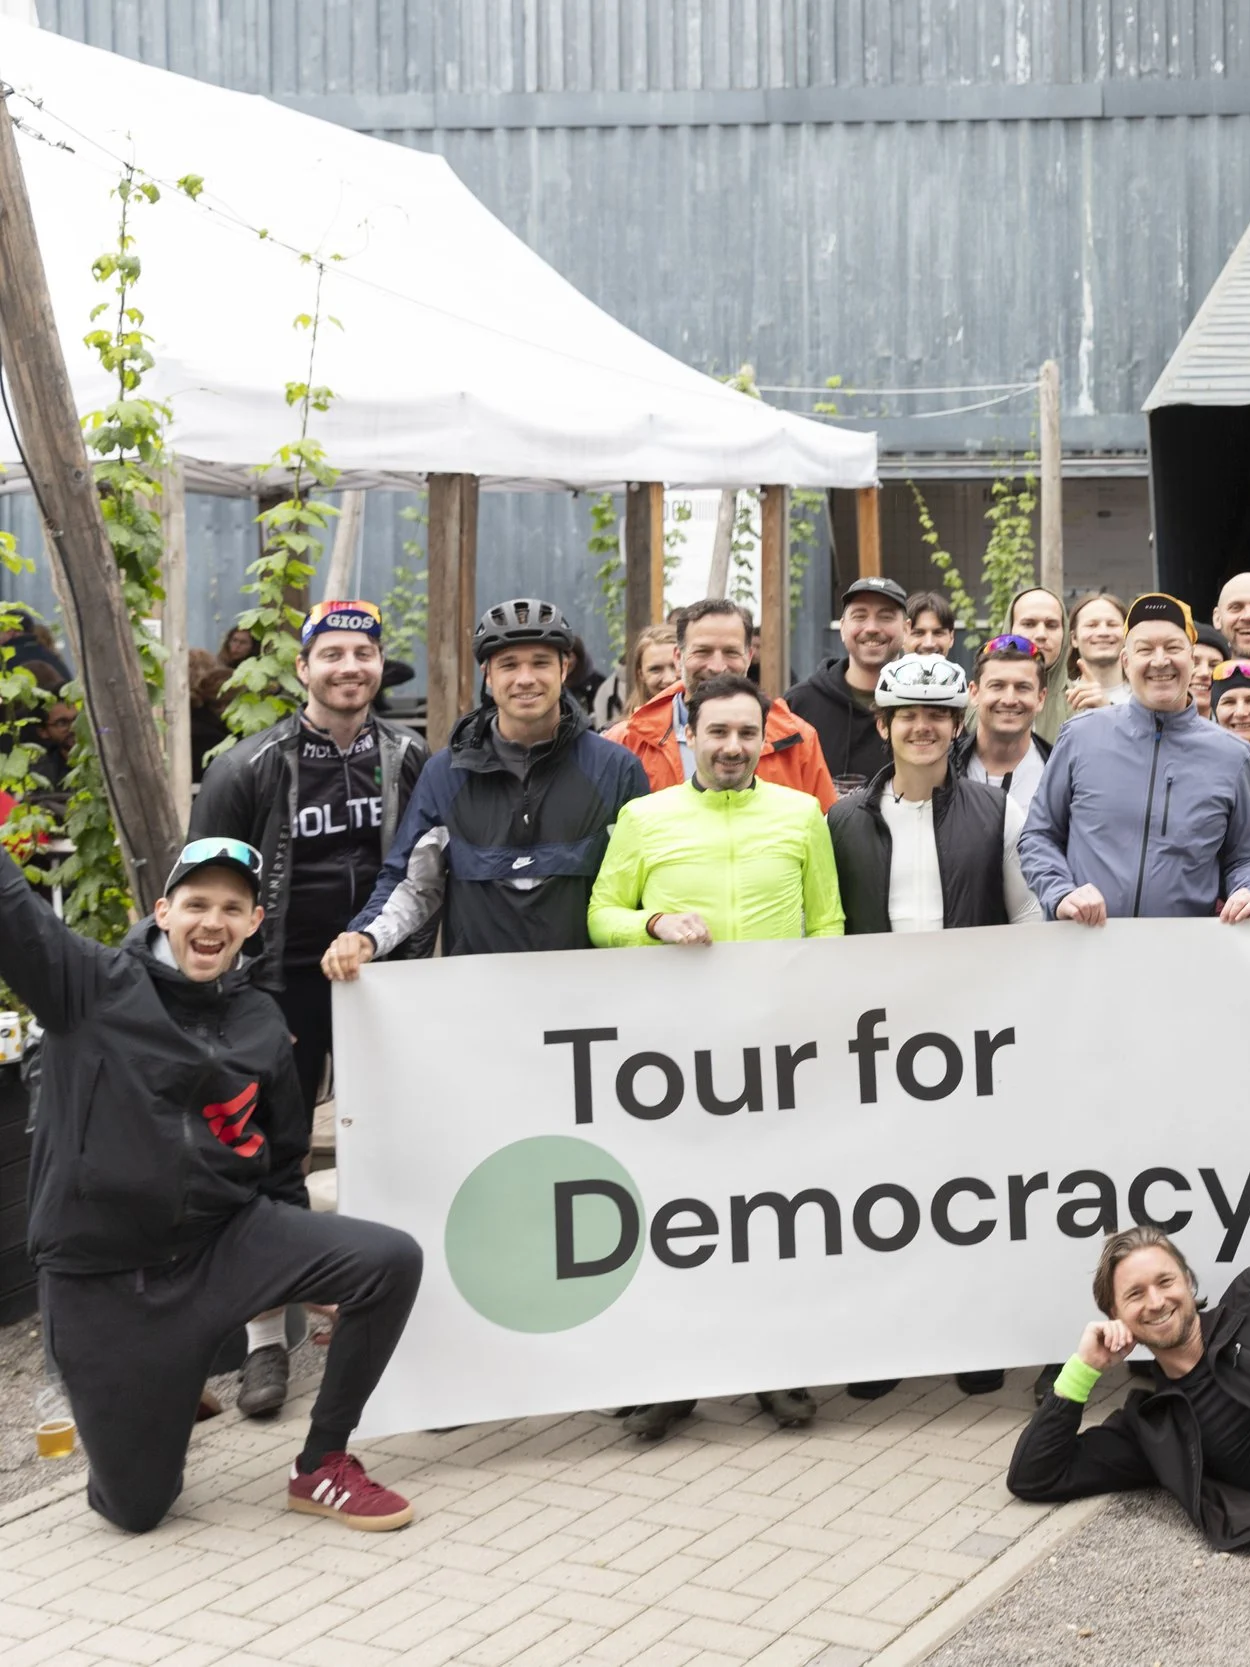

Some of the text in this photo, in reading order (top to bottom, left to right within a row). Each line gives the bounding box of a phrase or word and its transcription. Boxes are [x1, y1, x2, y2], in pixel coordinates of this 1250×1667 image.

[326, 613, 375, 630] GIOS
[543, 1007, 1016, 1126] Tour for
